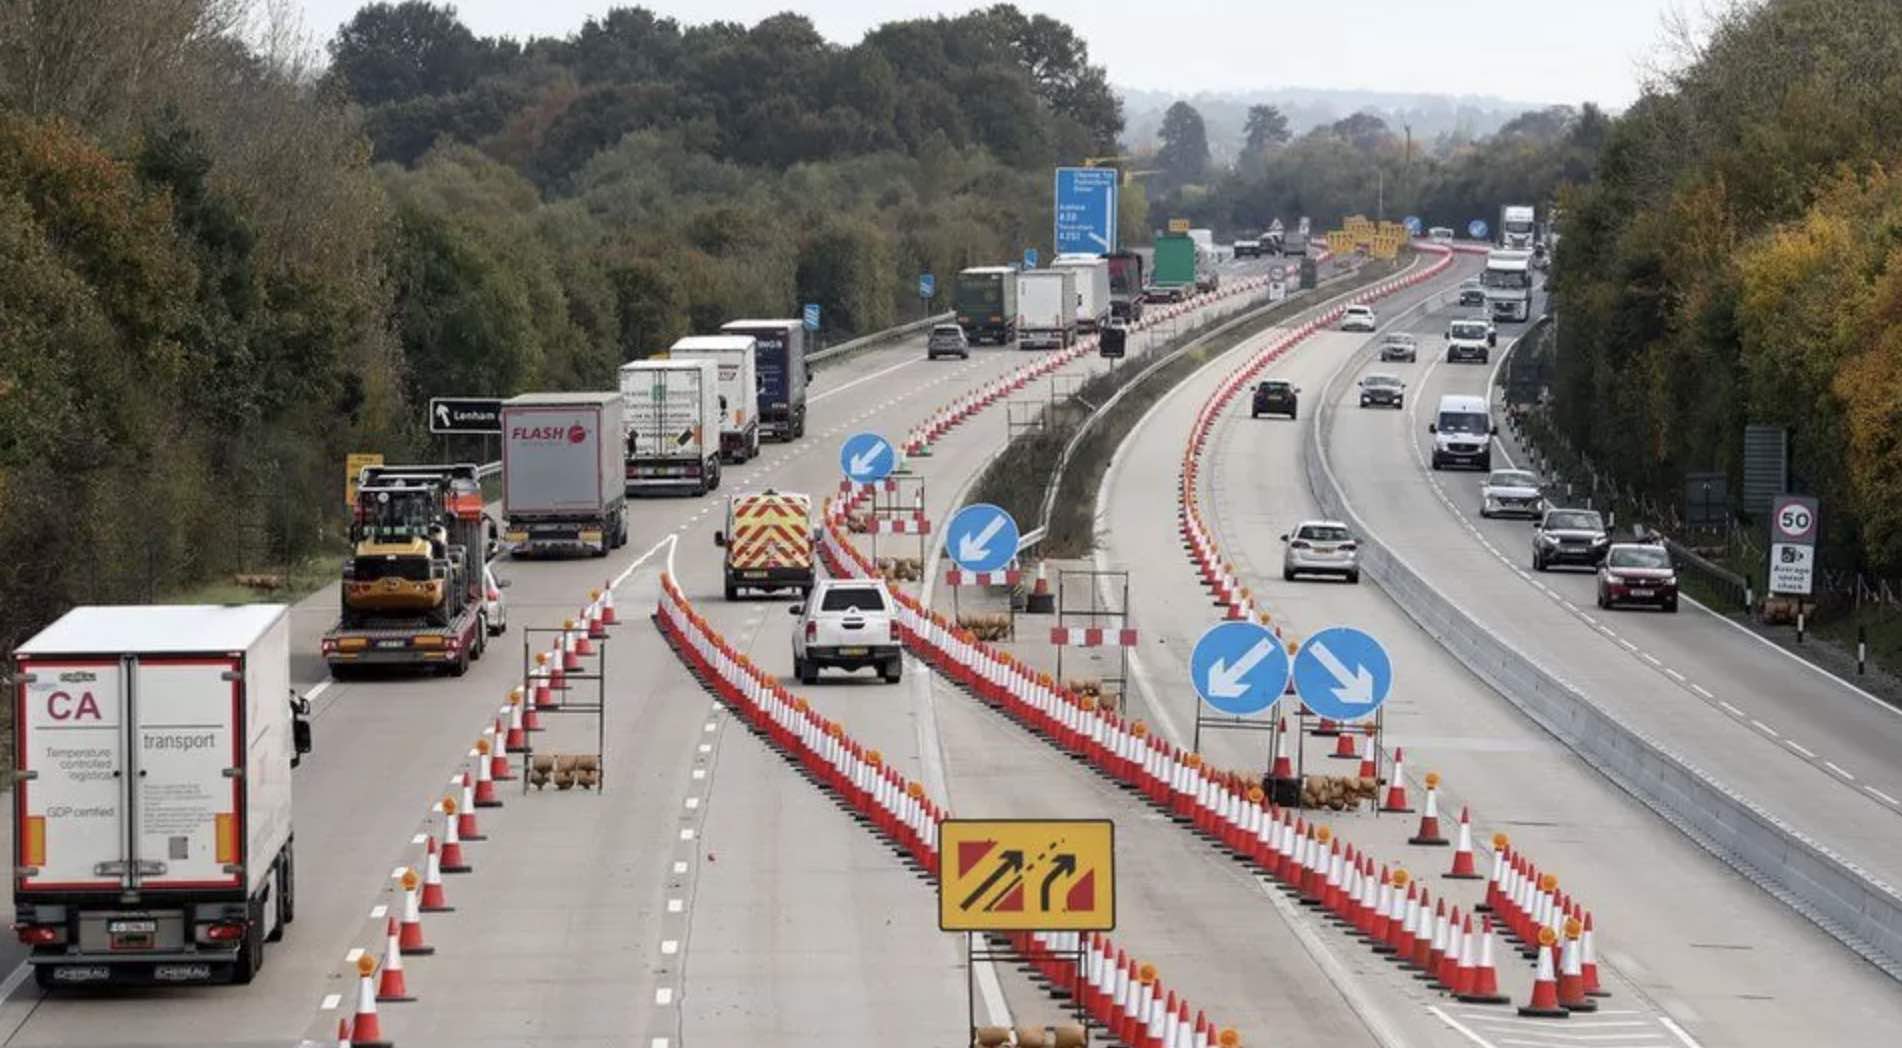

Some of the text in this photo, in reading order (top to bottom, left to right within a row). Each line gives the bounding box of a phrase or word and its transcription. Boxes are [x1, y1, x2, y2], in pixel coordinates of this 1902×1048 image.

[453, 410, 495, 420] Lenham
[511, 426, 565, 440] FLASH
[1782, 512, 1809, 529] 50
[47, 690, 102, 721] CA
[143, 732, 216, 752] transport
[46, 746, 113, 759] Temperature
[60, 758, 113, 770] controlled
[47, 805, 115, 818] GDP certified
